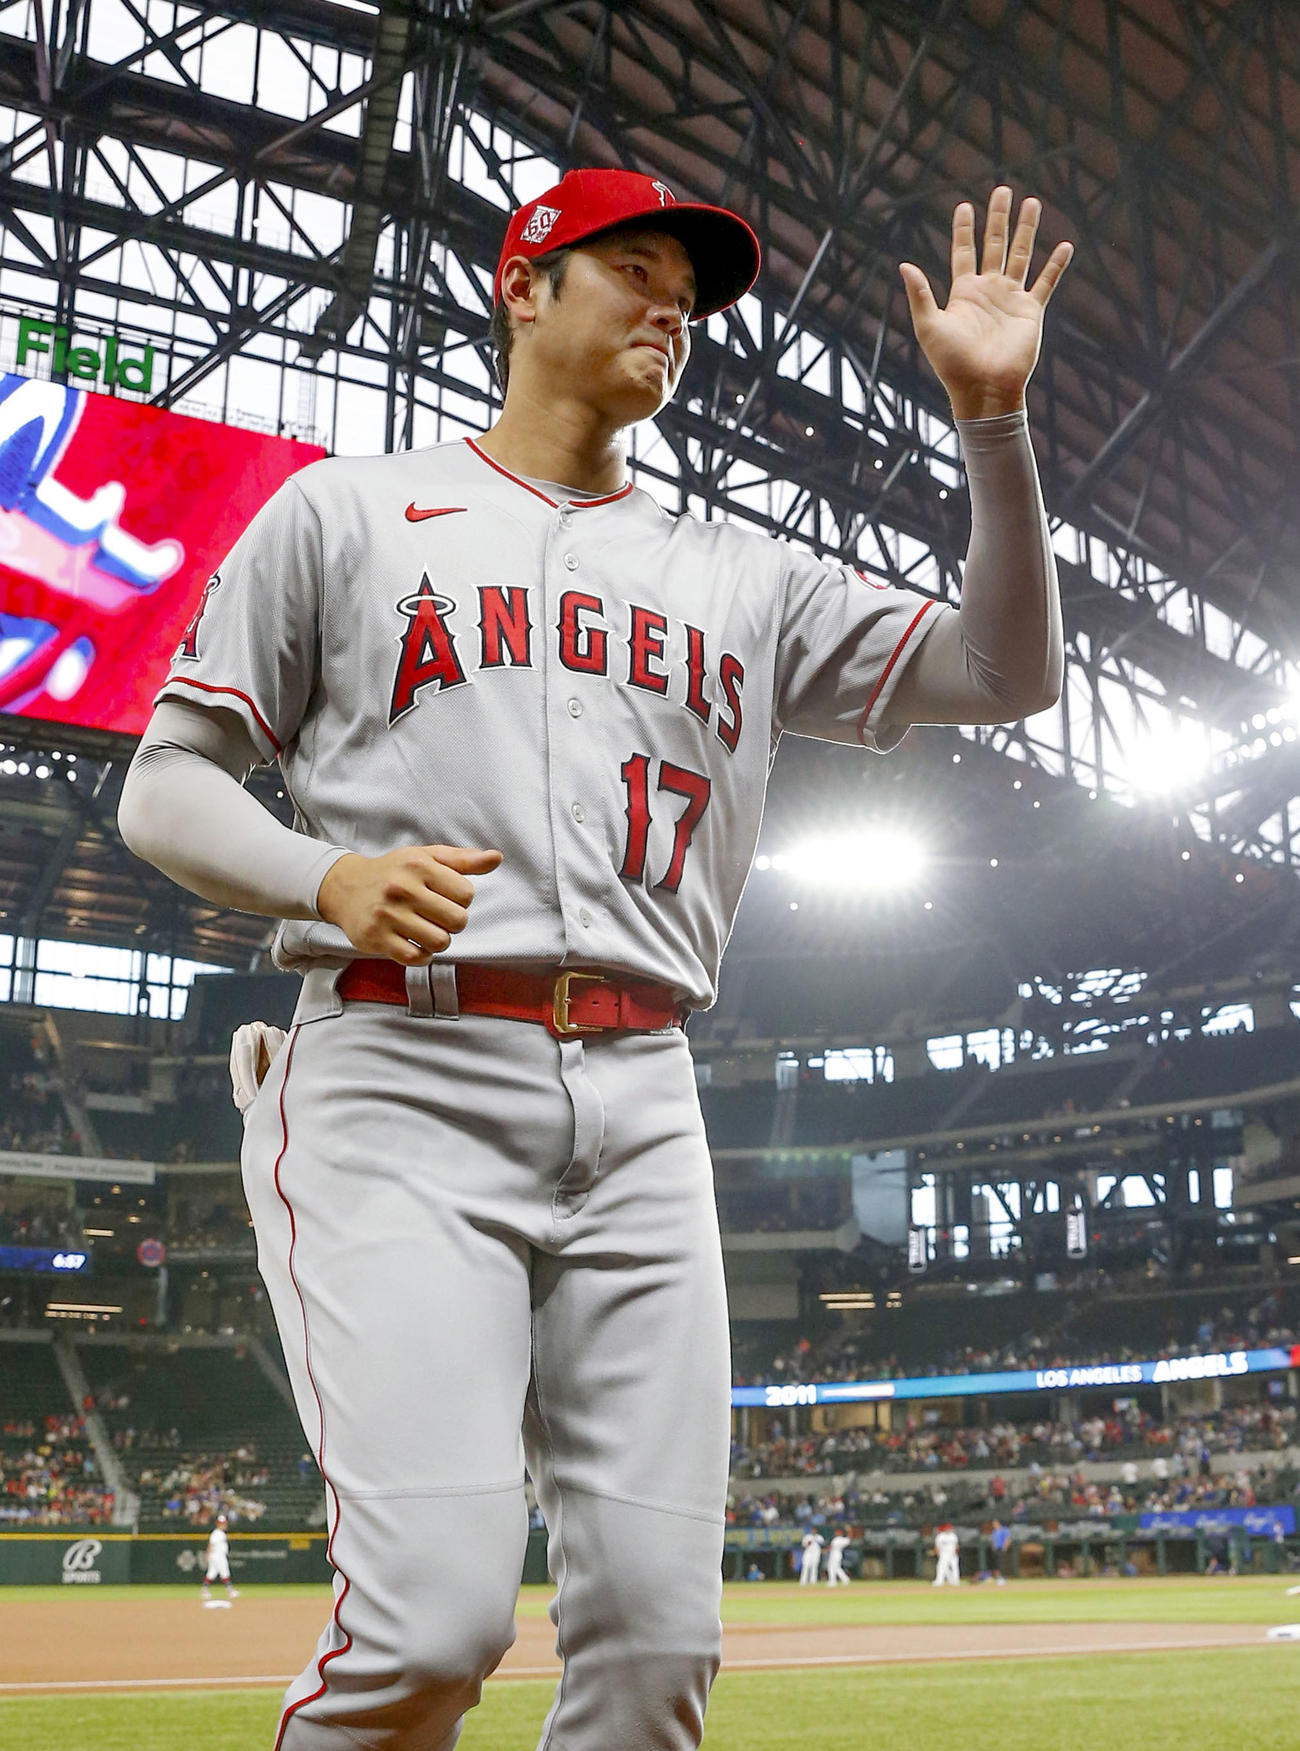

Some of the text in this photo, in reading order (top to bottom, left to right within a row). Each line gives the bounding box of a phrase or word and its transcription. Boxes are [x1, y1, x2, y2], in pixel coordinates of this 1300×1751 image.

[16, 317, 157, 393] Field
[387, 563, 745, 755] ANGELS
[618, 752, 712, 895] 17
[1036, 1351, 1249, 1388] LOS ANGELES ANGELS
